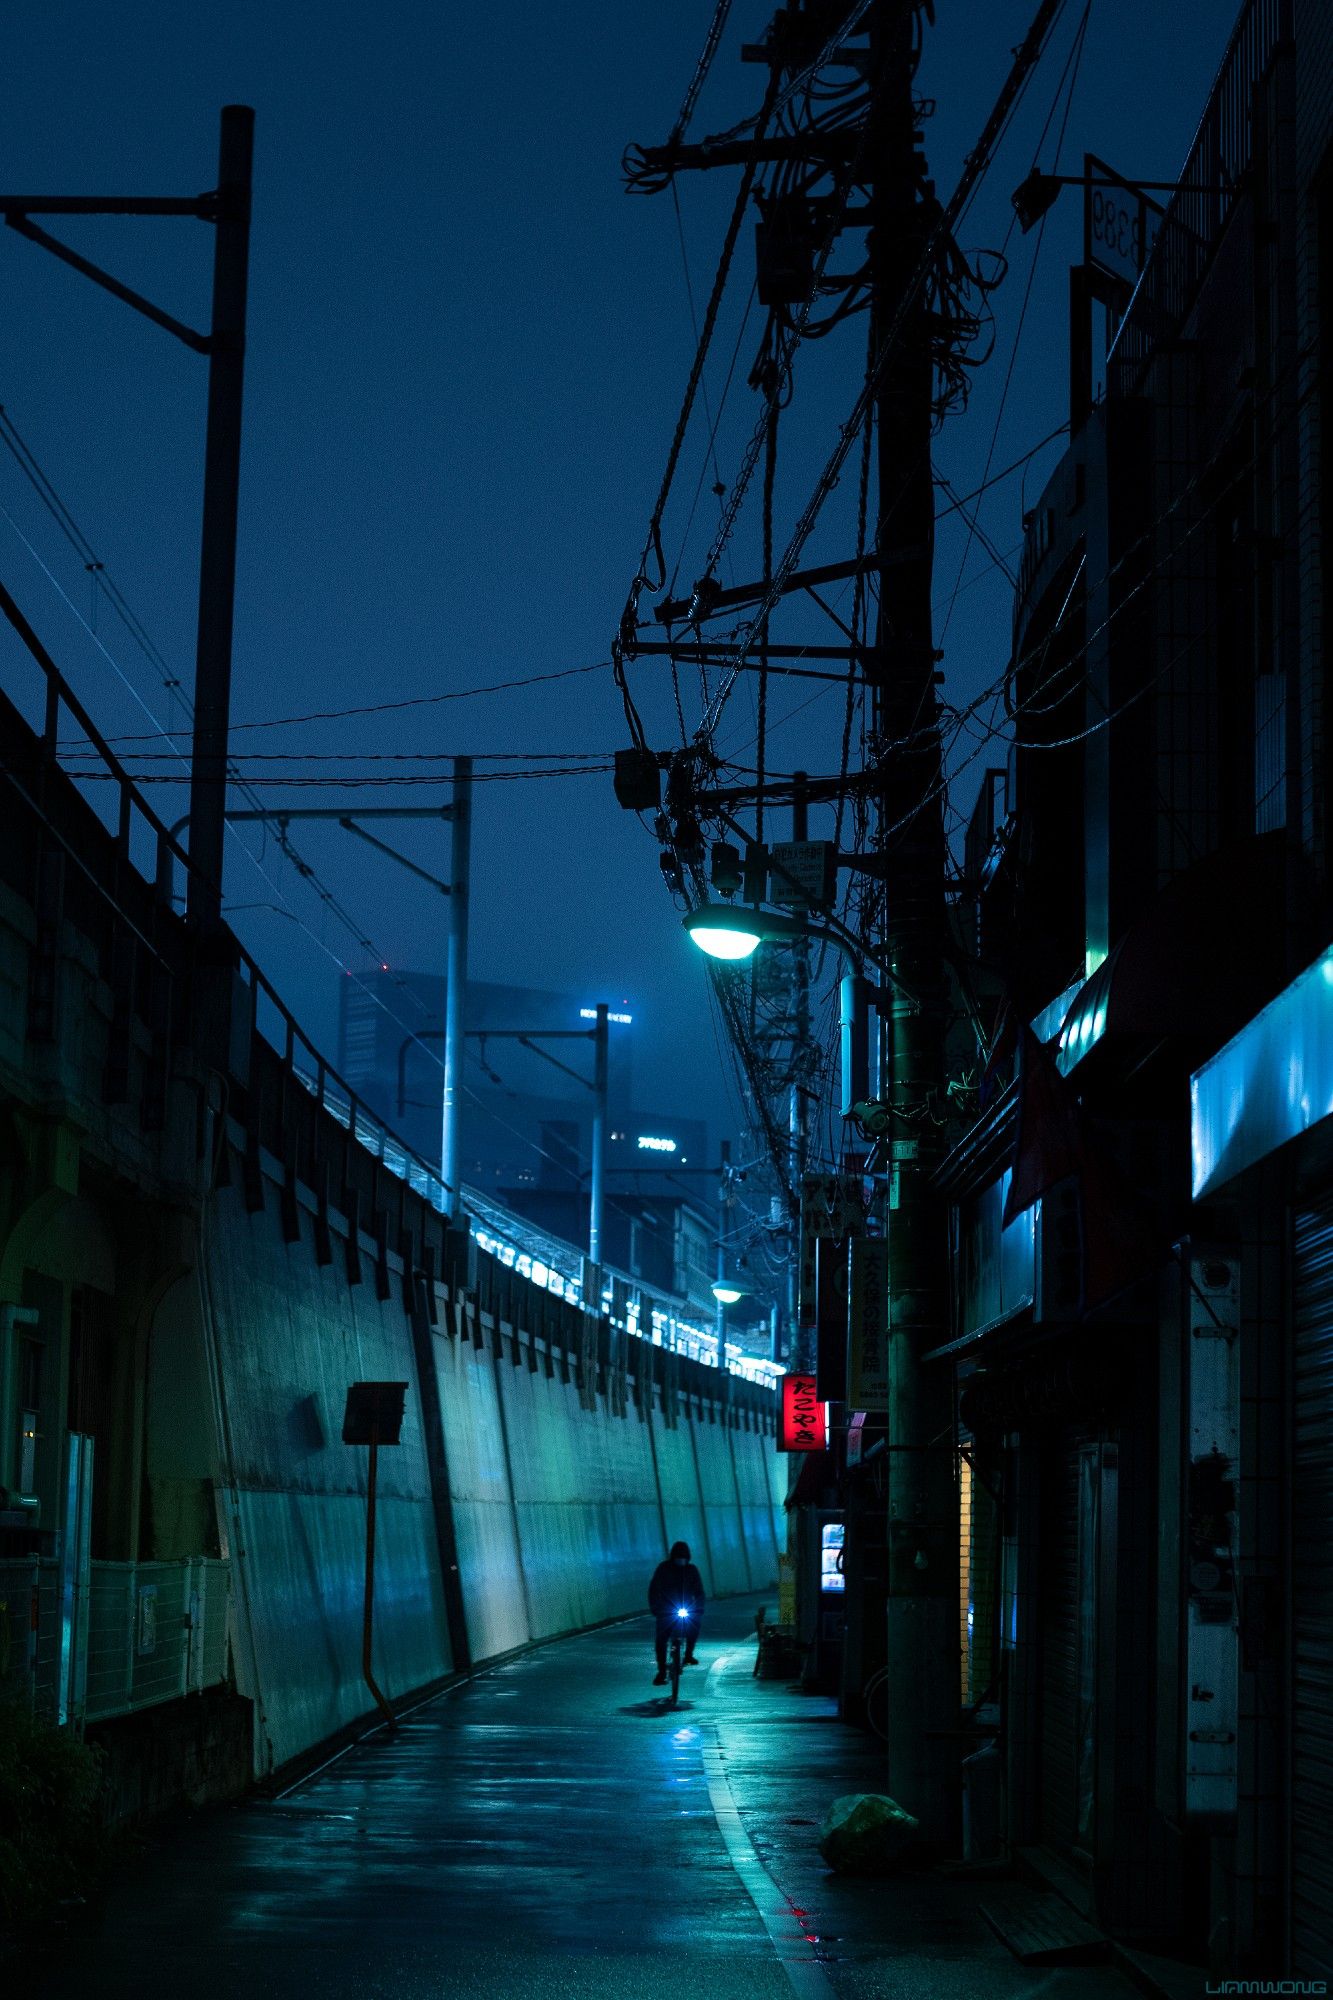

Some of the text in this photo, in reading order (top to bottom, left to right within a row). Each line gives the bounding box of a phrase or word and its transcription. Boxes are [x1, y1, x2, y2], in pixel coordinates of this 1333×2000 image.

[862, 1252, 882, 1374] 大久保の接骨院
[792, 1380, 817, 1444] たこやき
